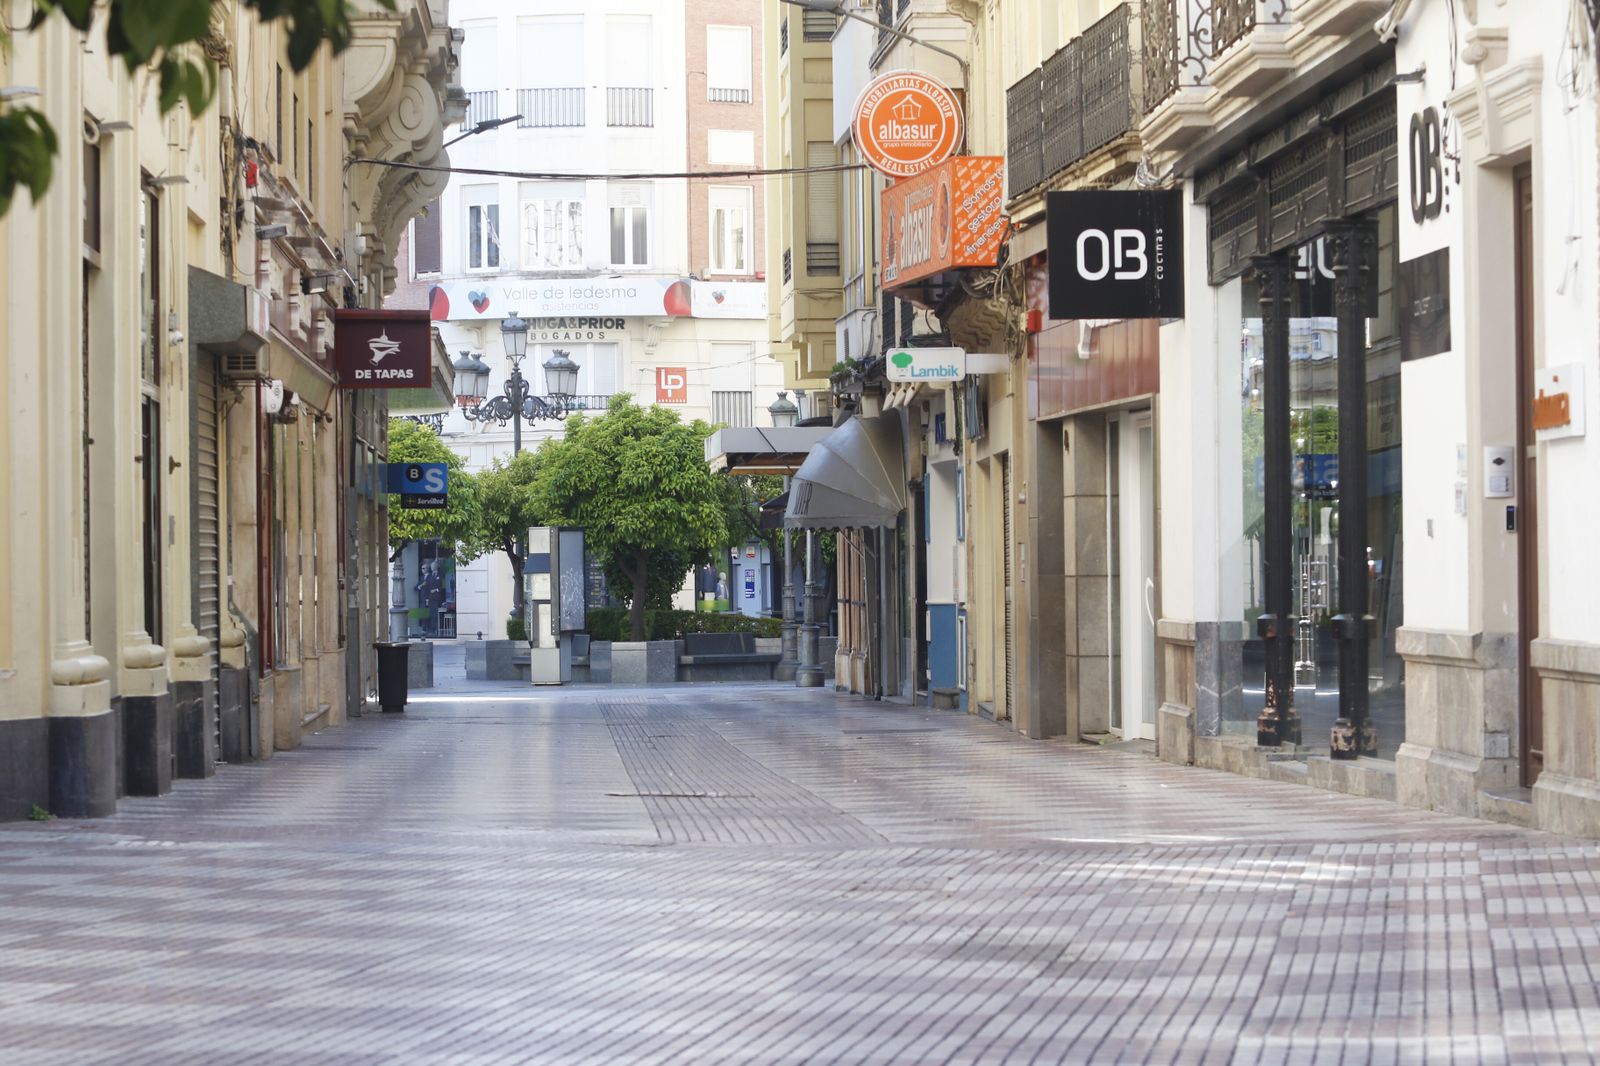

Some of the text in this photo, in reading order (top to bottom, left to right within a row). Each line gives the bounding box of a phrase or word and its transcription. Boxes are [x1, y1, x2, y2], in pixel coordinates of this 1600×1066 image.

[862, 78, 953, 118] INMOBILIARIAS ALBASUR
[879, 120, 936, 139] albasur
[881, 158, 936, 173] REAL ESTATE
[1409, 105, 1443, 226] OB
[1076, 228, 1148, 281] OB
[1155, 228, 1164, 280] cocinas
[502, 285, 637, 300] Valle de ledesma
[542, 301, 599, 312] asistencias
[355, 369, 414, 379] DE TAPAS
[911, 365, 959, 377] Lambik
